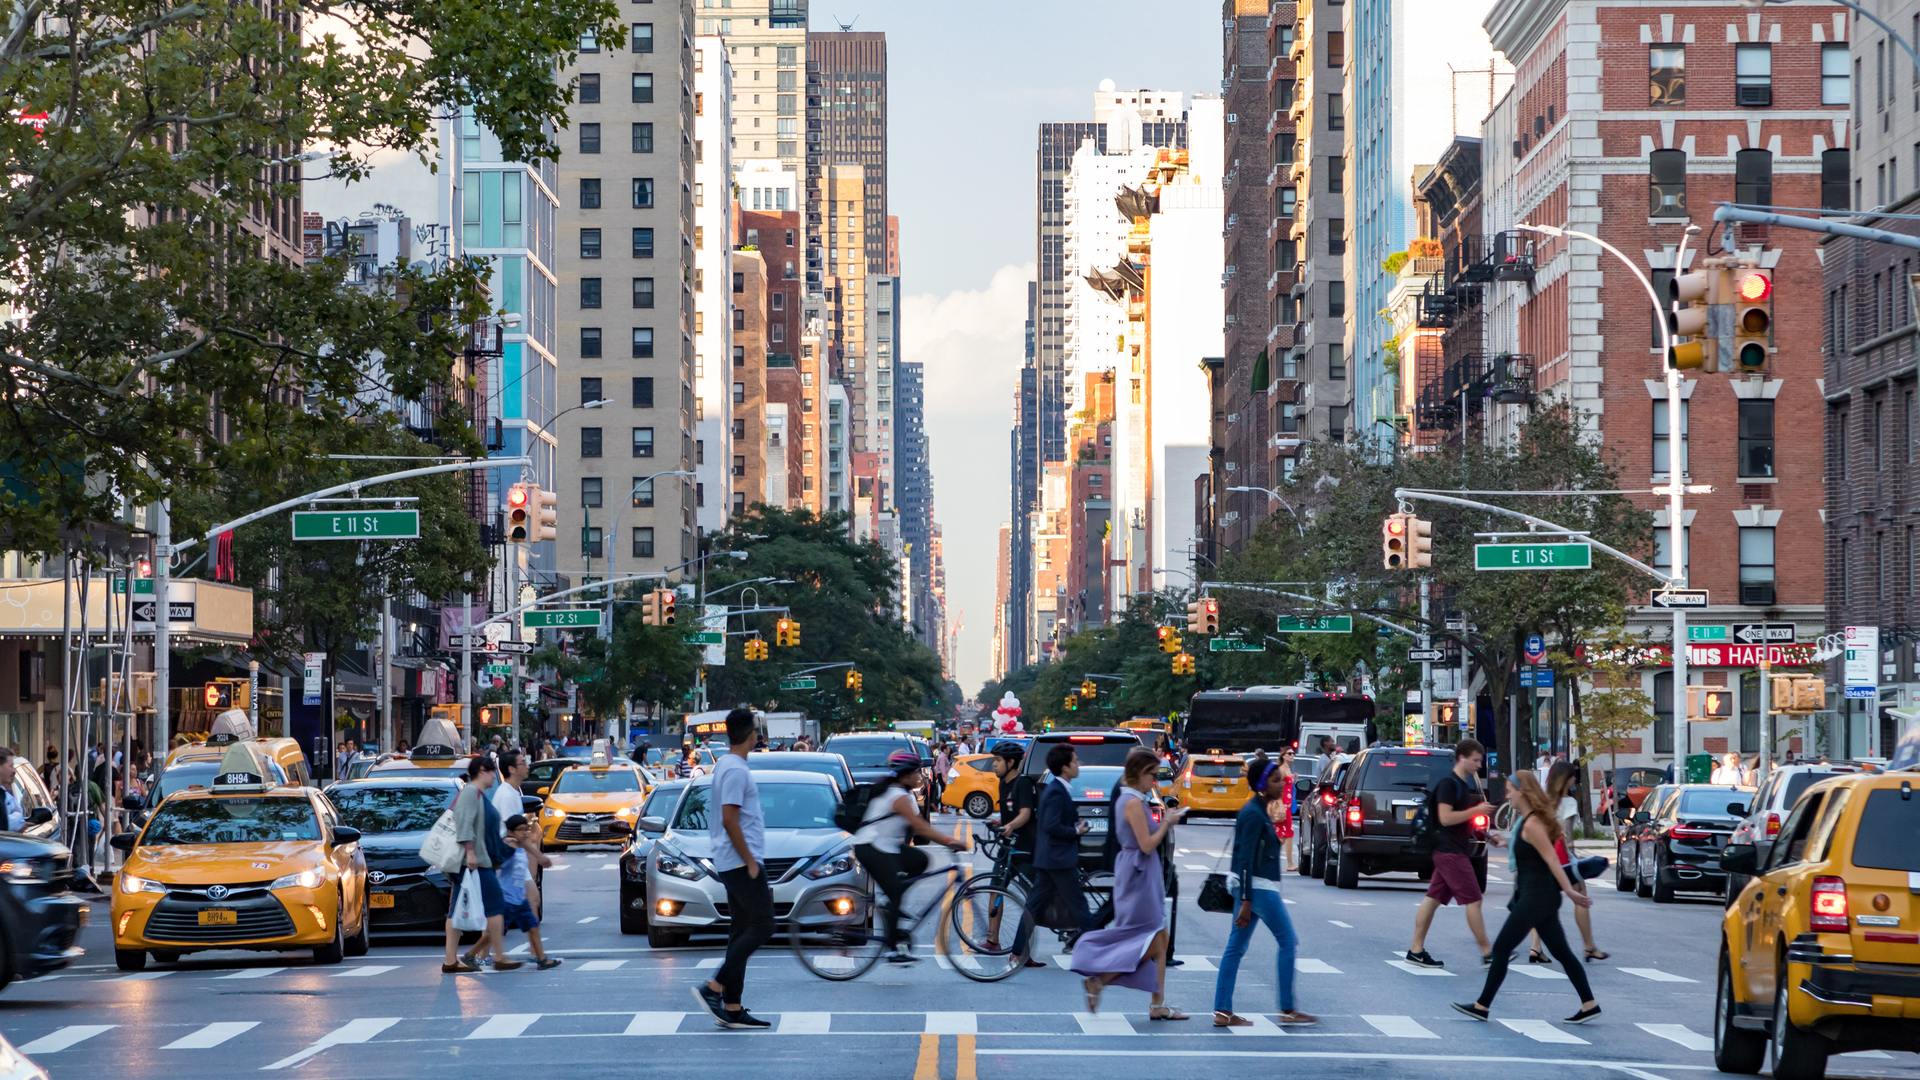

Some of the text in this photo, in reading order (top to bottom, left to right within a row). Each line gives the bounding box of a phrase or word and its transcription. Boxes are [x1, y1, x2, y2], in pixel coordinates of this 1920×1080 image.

[333, 516, 379, 533] E 11 St
[1512, 549, 1554, 564] E 11 St
[117, 580, 125, 593] E
[522, 592, 535, 600] BAR
[1662, 595, 1678, 603] ONE
[143, 607, 188, 617] ON WAY
[546, 613, 578, 624] E 12 St
[1320, 618, 1330, 629] St
[1693, 627, 1699, 638] E
[1703, 627, 1710, 638] 11
[1744, 630, 1789, 639] ONE WAY
[1849, 650, 1854, 660] 1
[489, 665, 494, 673] E
[495, 665, 503, 673] 12
[426, 745, 441, 755] 7C47
[1491, 757, 1497, 766] P
[227, 773, 248, 784] 8H94
